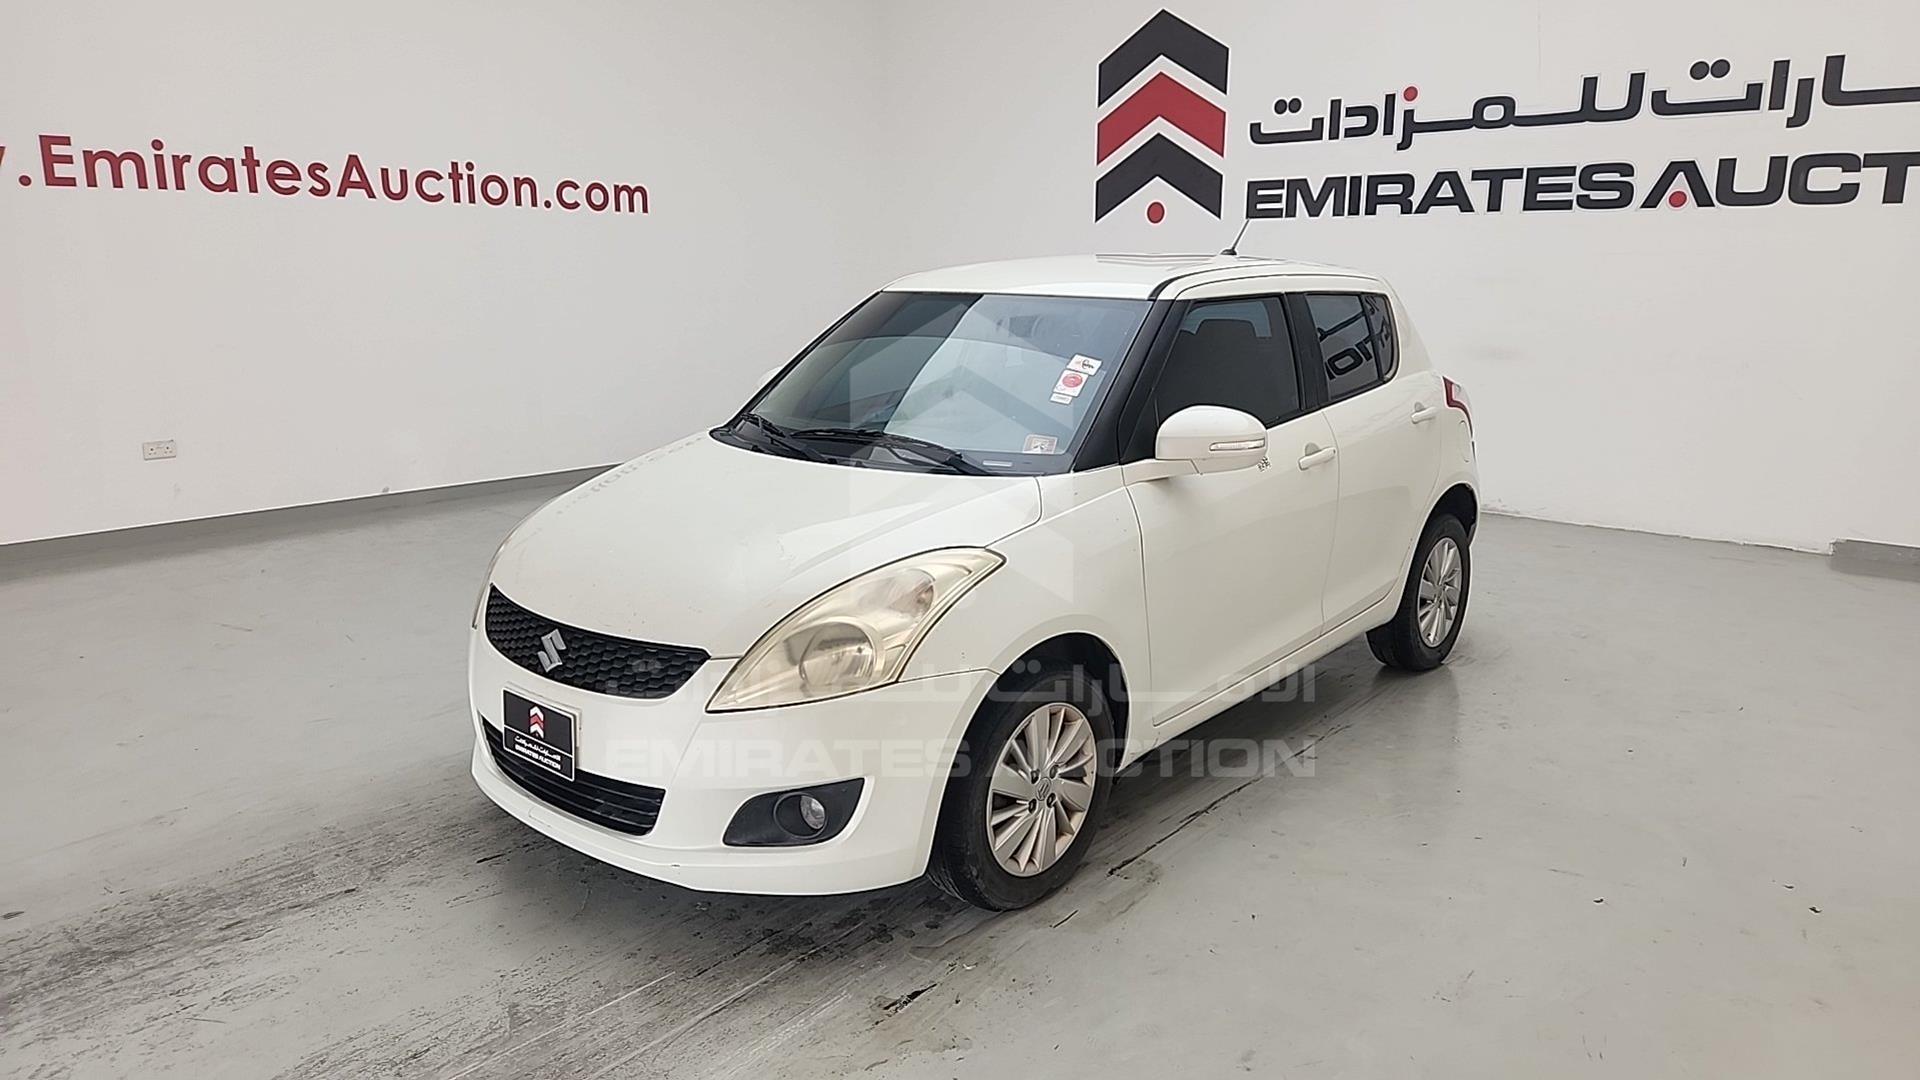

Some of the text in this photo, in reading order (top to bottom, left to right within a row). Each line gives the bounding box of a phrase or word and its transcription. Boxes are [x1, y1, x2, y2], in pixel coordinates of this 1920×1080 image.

[1249, 55, 1920, 152] ارات للمزادات
[0, 134, 649, 214] .EmiratesAuction.com
[1246, 162, 1636, 220] EMIRATES
